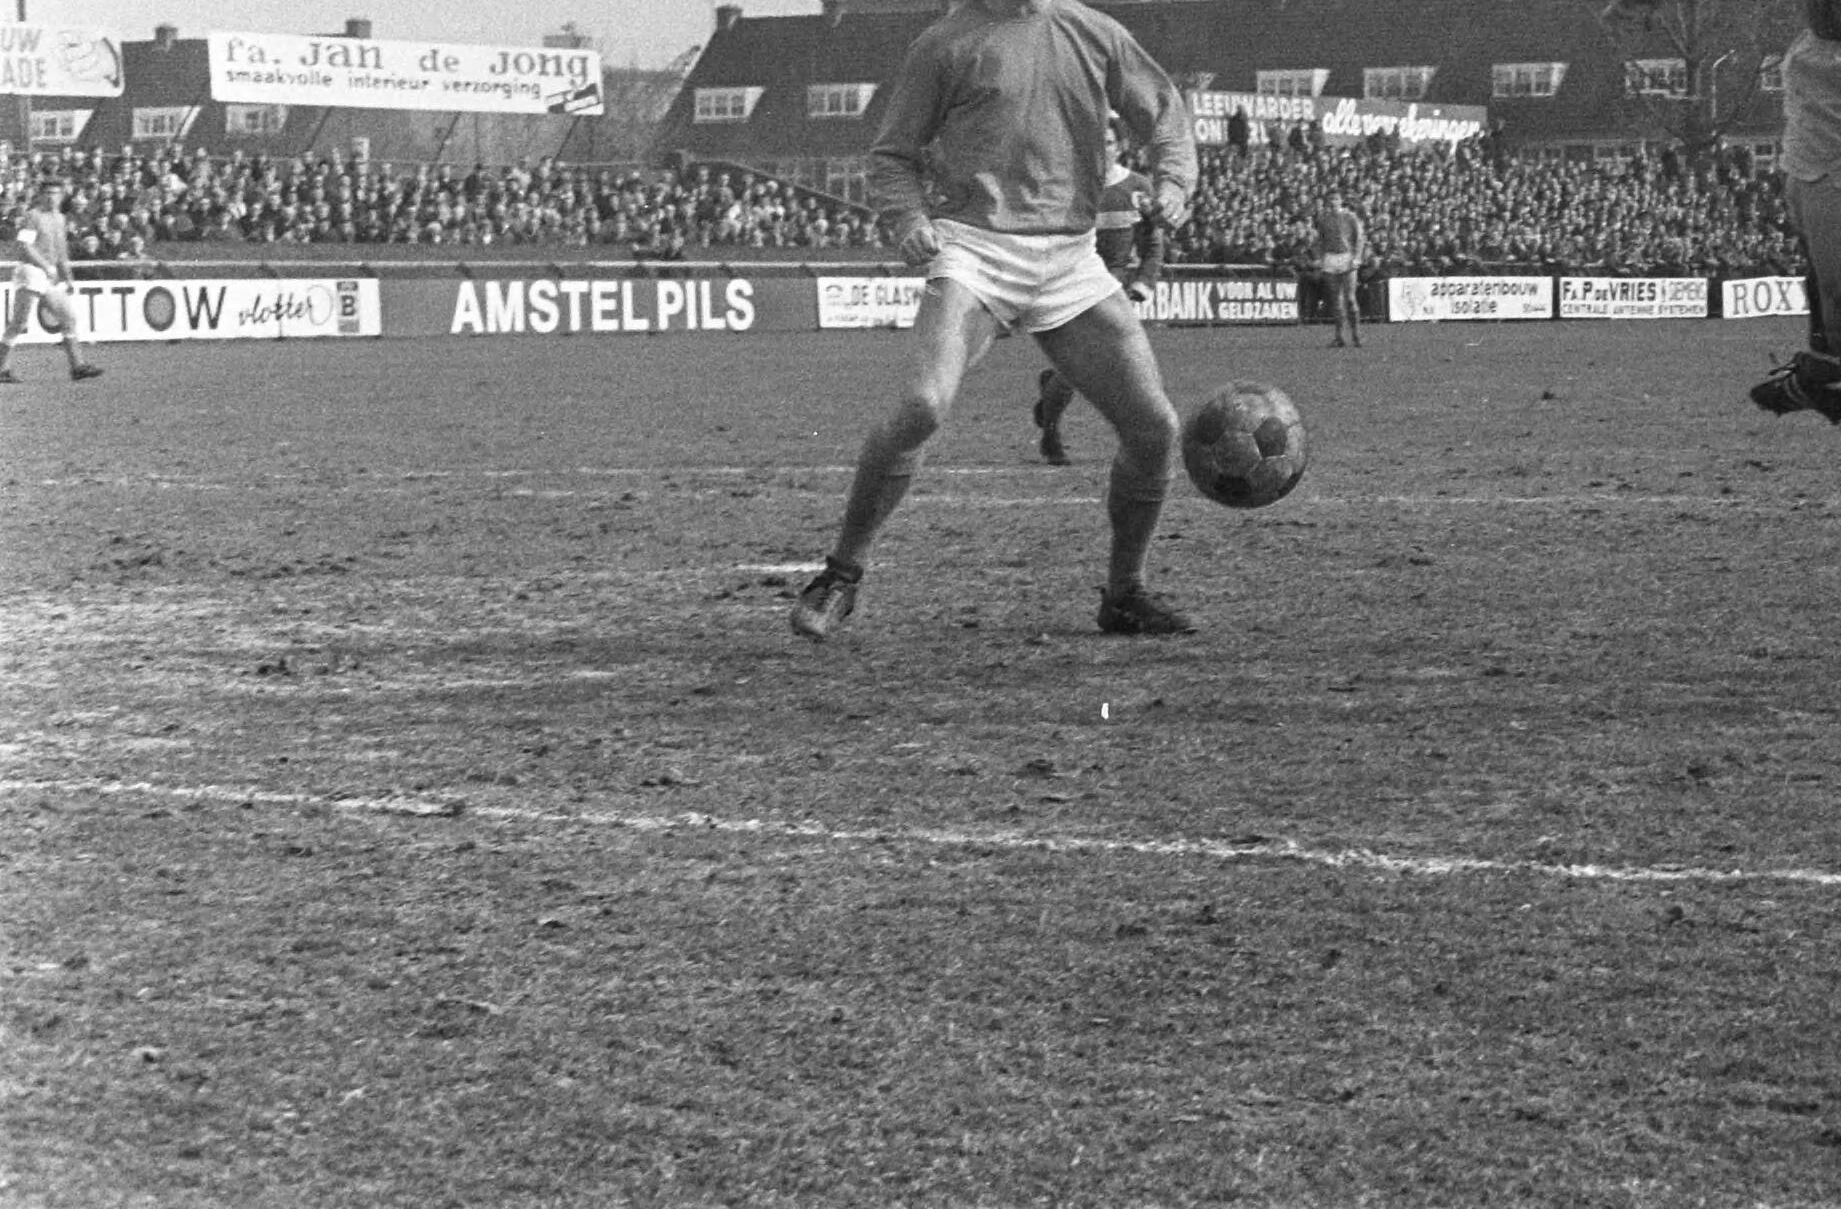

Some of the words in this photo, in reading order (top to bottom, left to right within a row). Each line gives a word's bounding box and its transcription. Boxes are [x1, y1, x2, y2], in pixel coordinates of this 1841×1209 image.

[227, 38, 281, 64] fa.
[300, 42, 383, 69] Jan
[419, 49, 460, 72] de
[489, 51, 590, 88] Jong
[226, 69, 333, 87] smaakvolle
[442, 78, 541, 99] verzorging
[1193, 92, 1316, 121] LEEUWARDER
[1322, 98, 1361, 136] alle
[451, 280, 649, 333] AMSTEL
[657, 279, 755, 331] PILS
[1136, 282, 1214, 319] RBANK
[1256, 282, 1274, 300] AL
[1609, 281, 1656, 302] VRIES
[1218, 302, 1298, 320] GELDZAKEN
